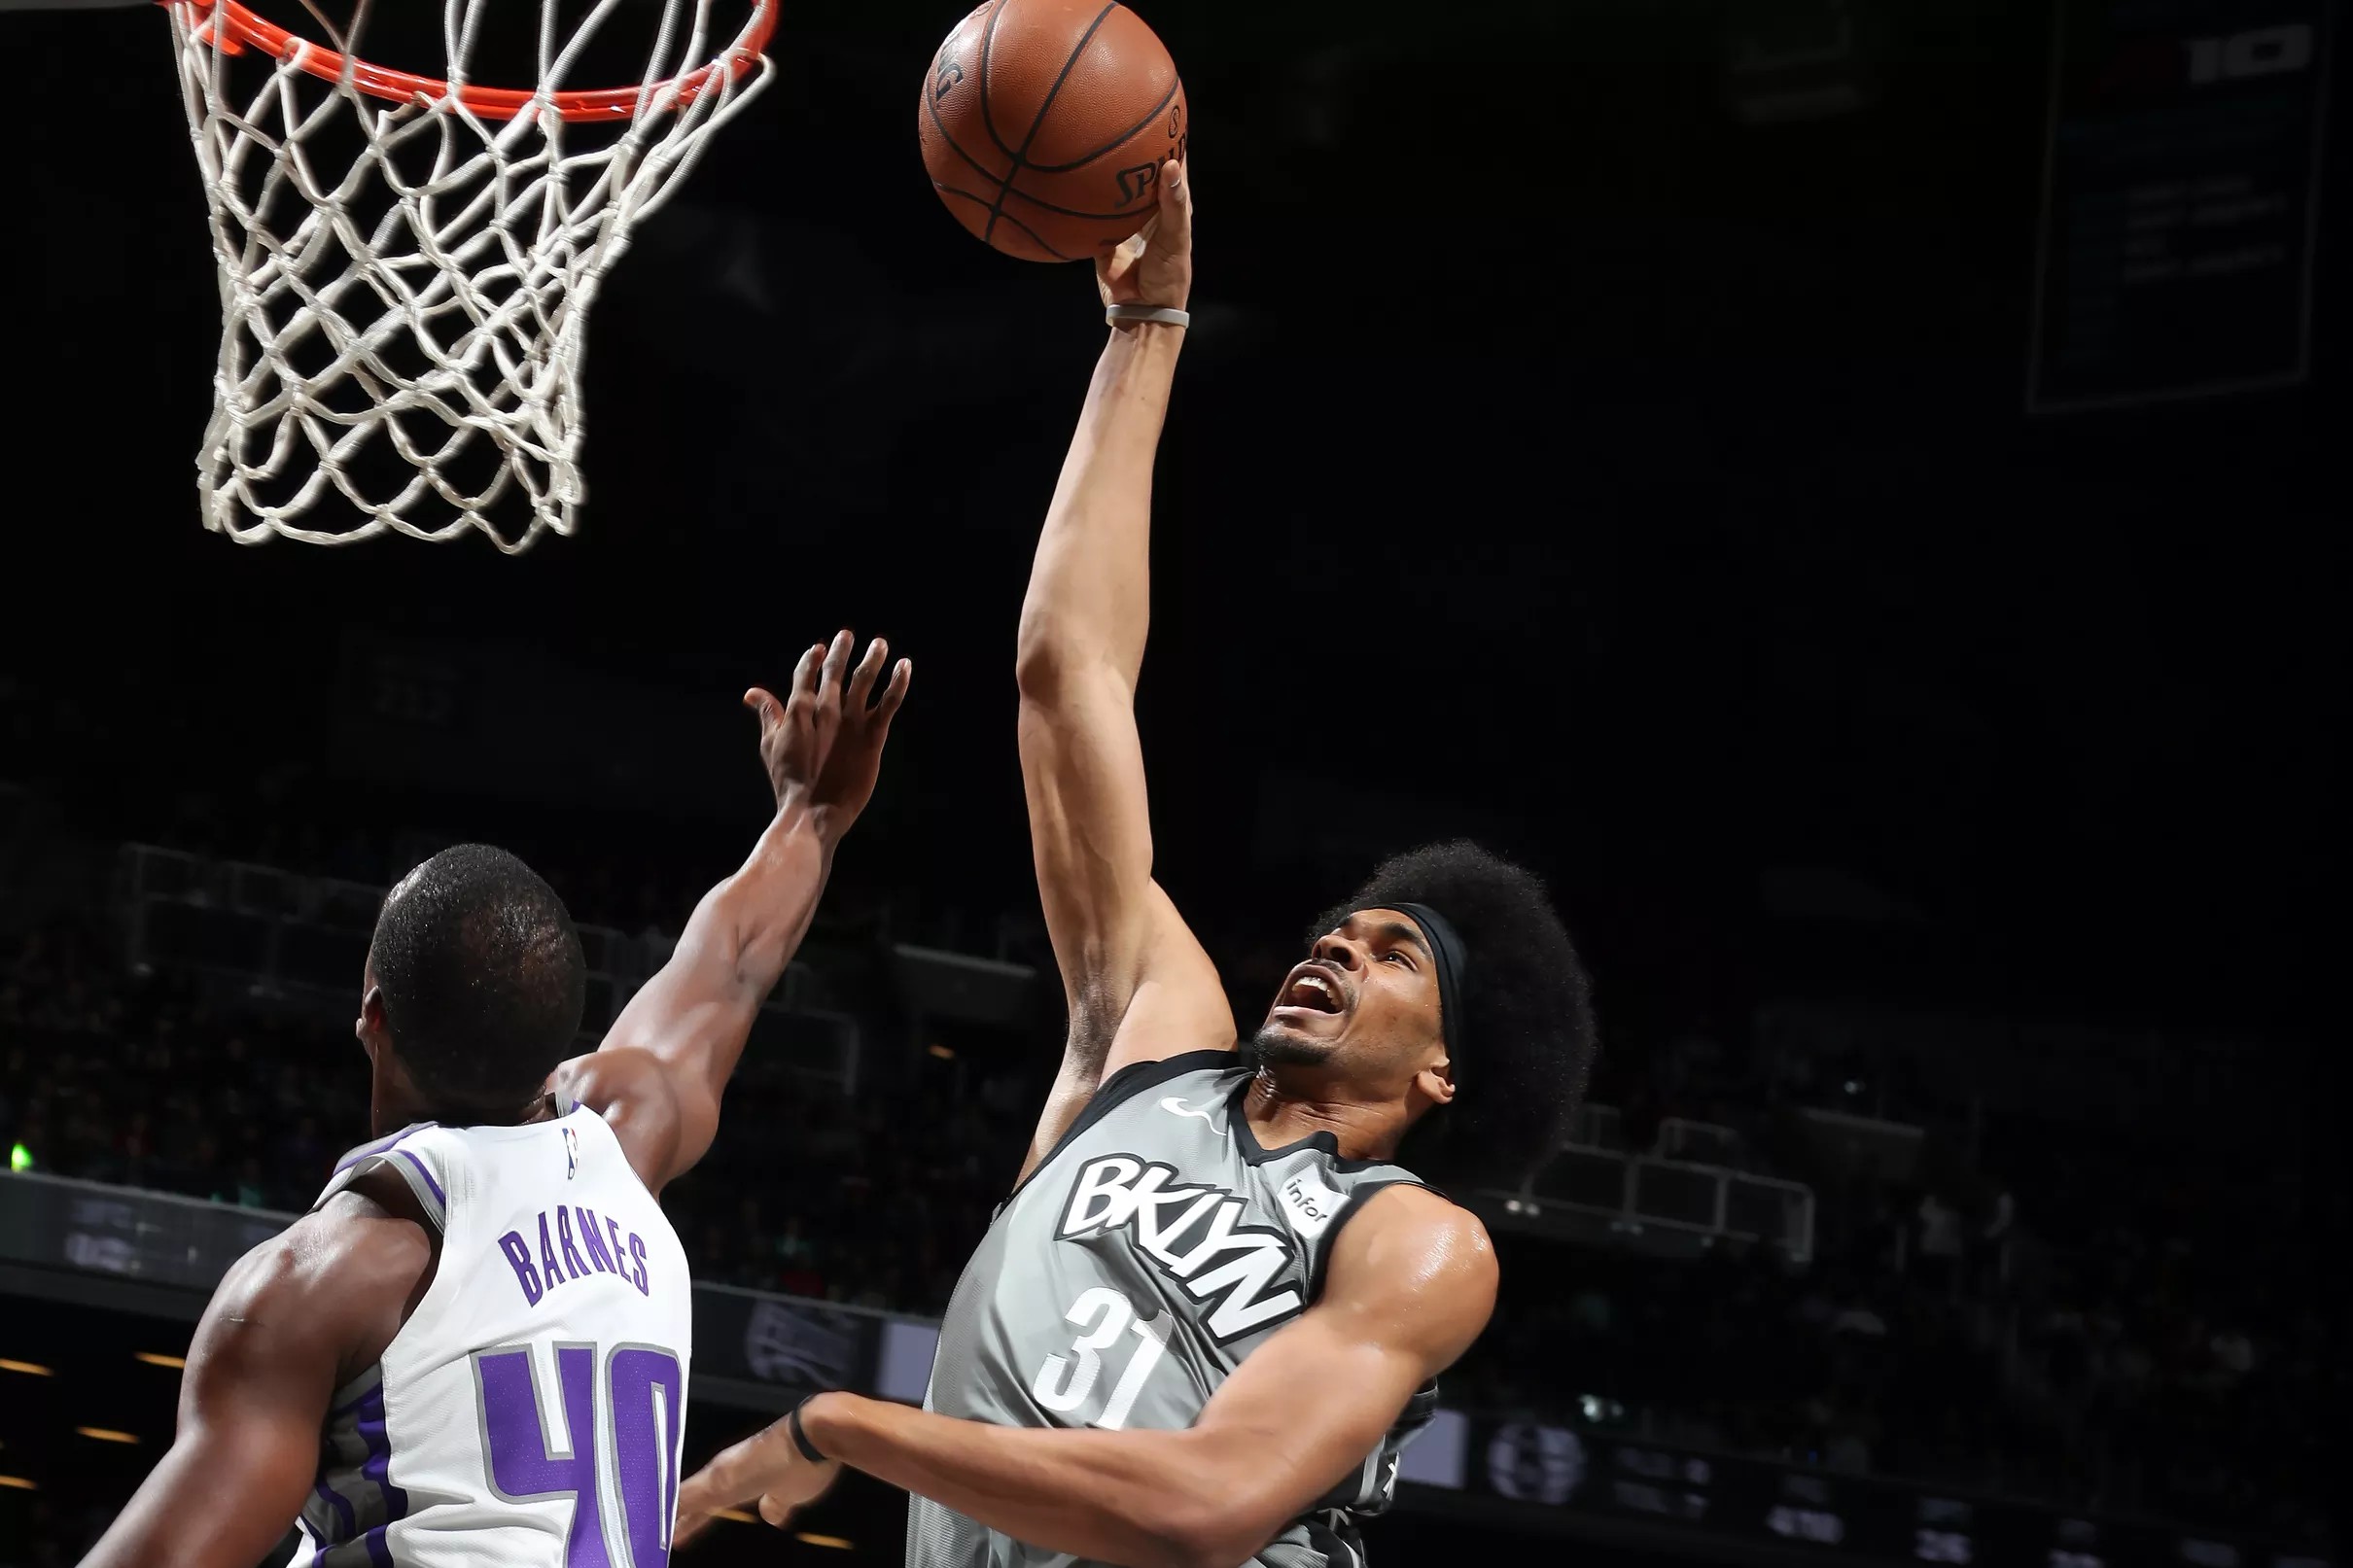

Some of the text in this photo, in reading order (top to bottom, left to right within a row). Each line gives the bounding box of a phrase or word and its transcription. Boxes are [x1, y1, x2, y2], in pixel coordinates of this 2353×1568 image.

[498, 1204, 650, 1307] BARNES
[1054, 1152, 1309, 1348] BKLYN
[1286, 1178, 1328, 1222] infor
[1033, 1286, 1173, 1431] 31
[469, 1341, 683, 1568] 40
